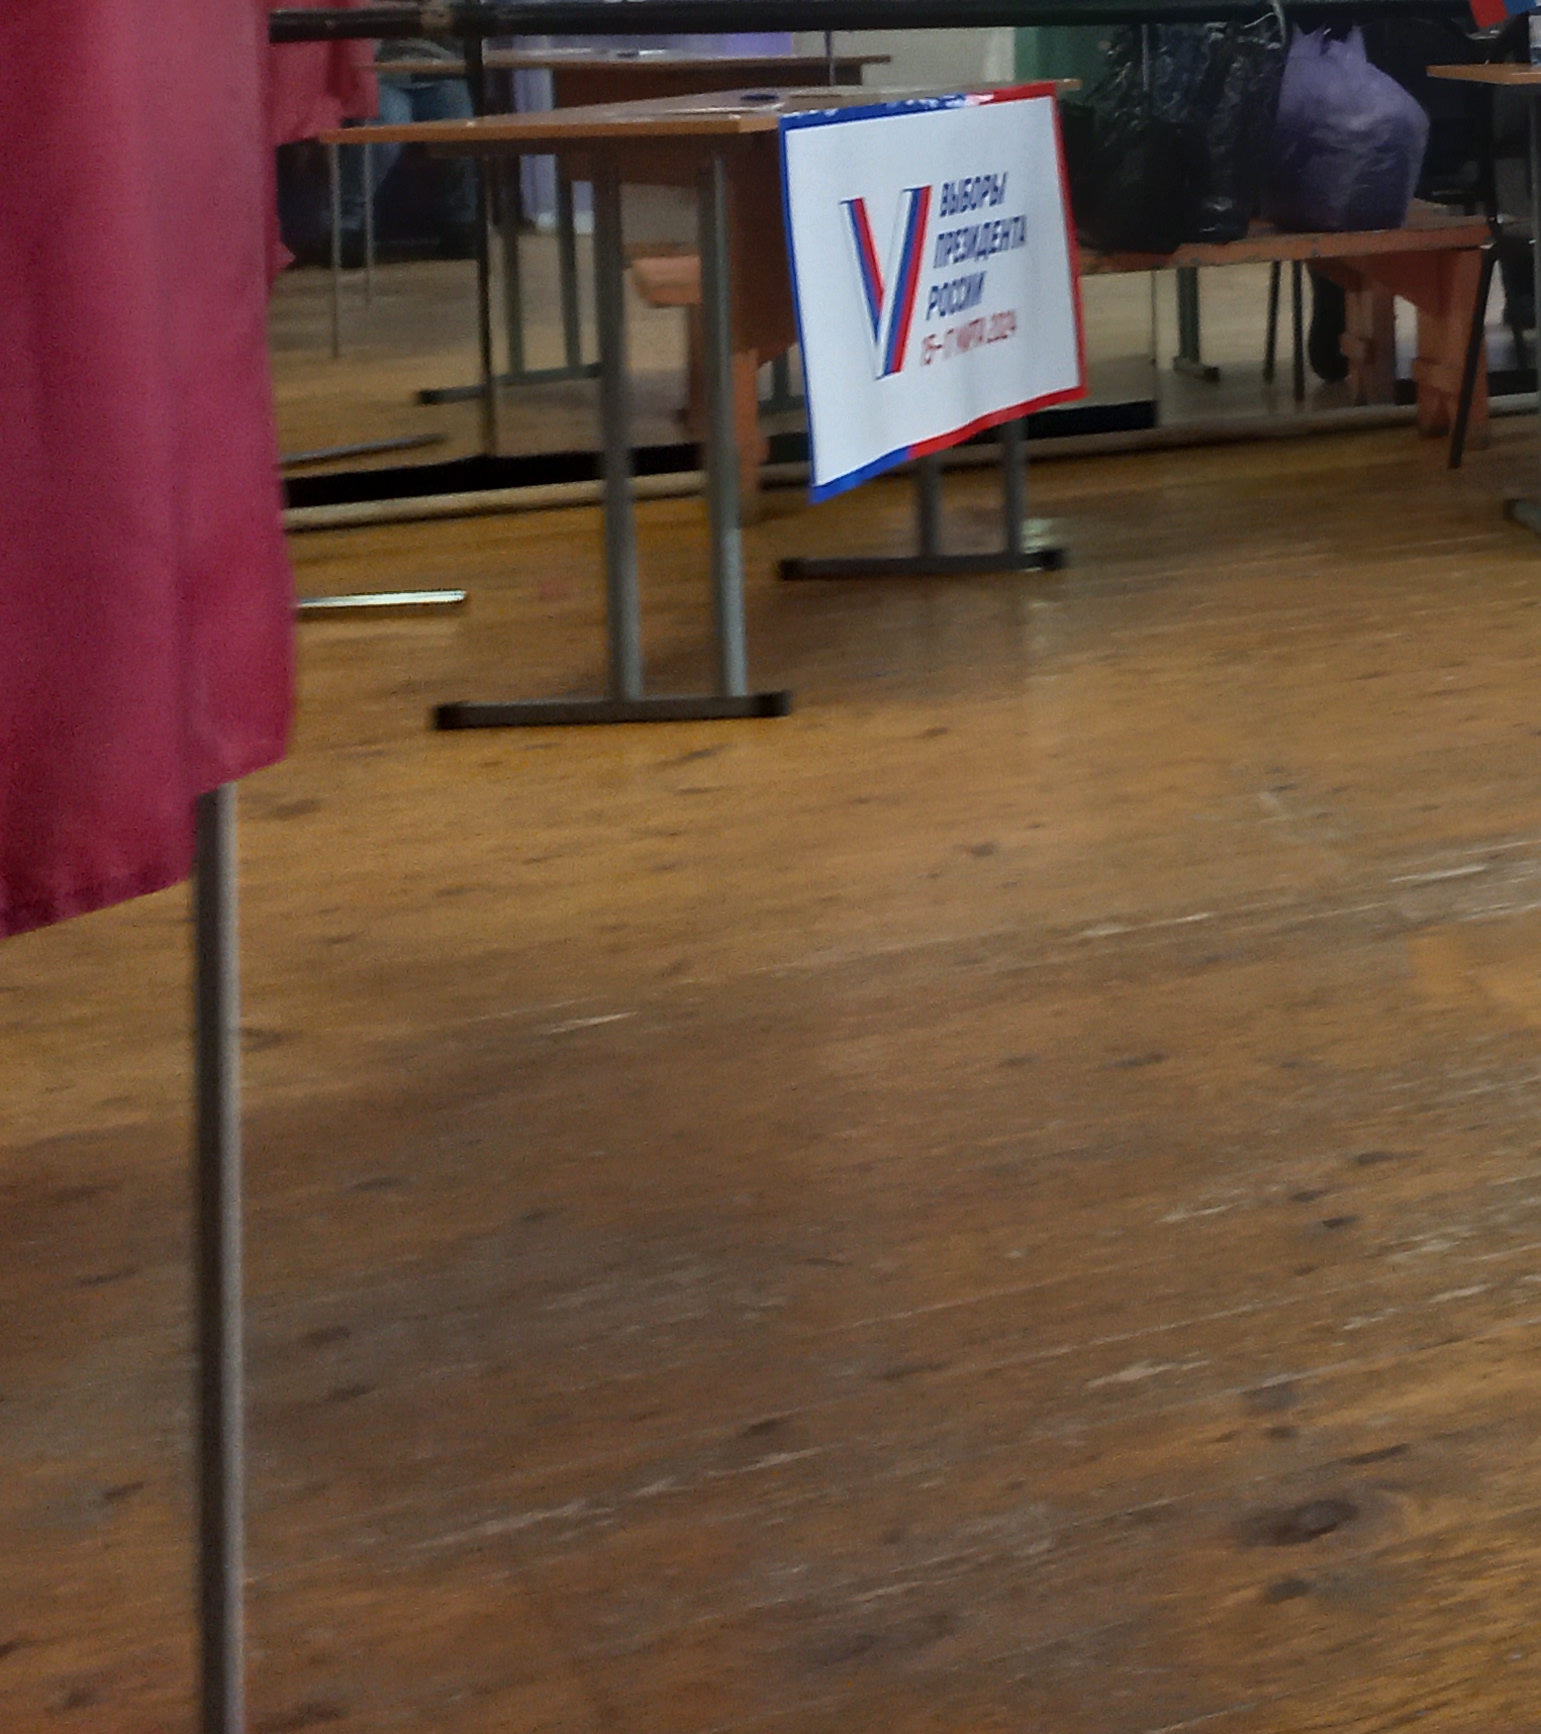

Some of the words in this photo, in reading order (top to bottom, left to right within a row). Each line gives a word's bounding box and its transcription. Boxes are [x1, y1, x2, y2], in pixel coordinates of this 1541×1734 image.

[939, 170, 1009, 218] ВЫБОРЫ
[933, 213, 1028, 269] ПРЕЗИДЕНТА
[926, 270, 987, 322] РОССИИ
